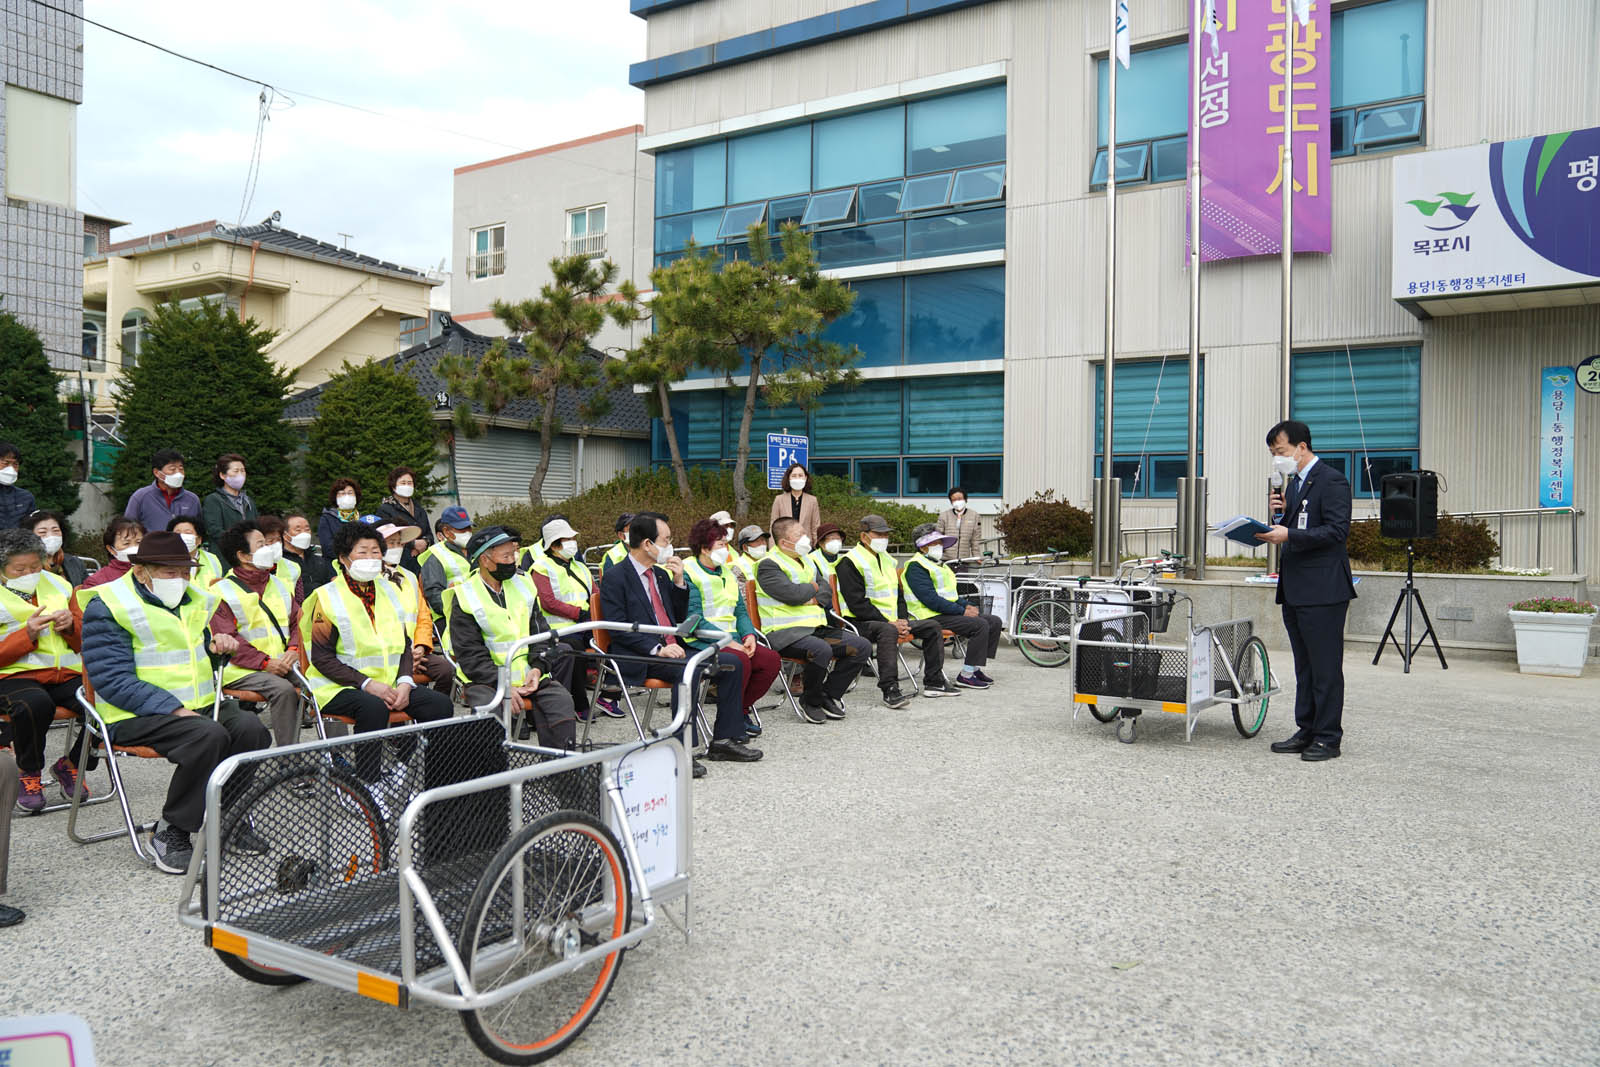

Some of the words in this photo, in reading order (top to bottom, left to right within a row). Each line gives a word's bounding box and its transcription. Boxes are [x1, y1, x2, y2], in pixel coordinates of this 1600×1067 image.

[1200, 51, 1229, 129] 선정
[1567, 155, 1600, 192] 평
[1412, 235, 1471, 256] 목포시
[778, 448, 788, 467] P
